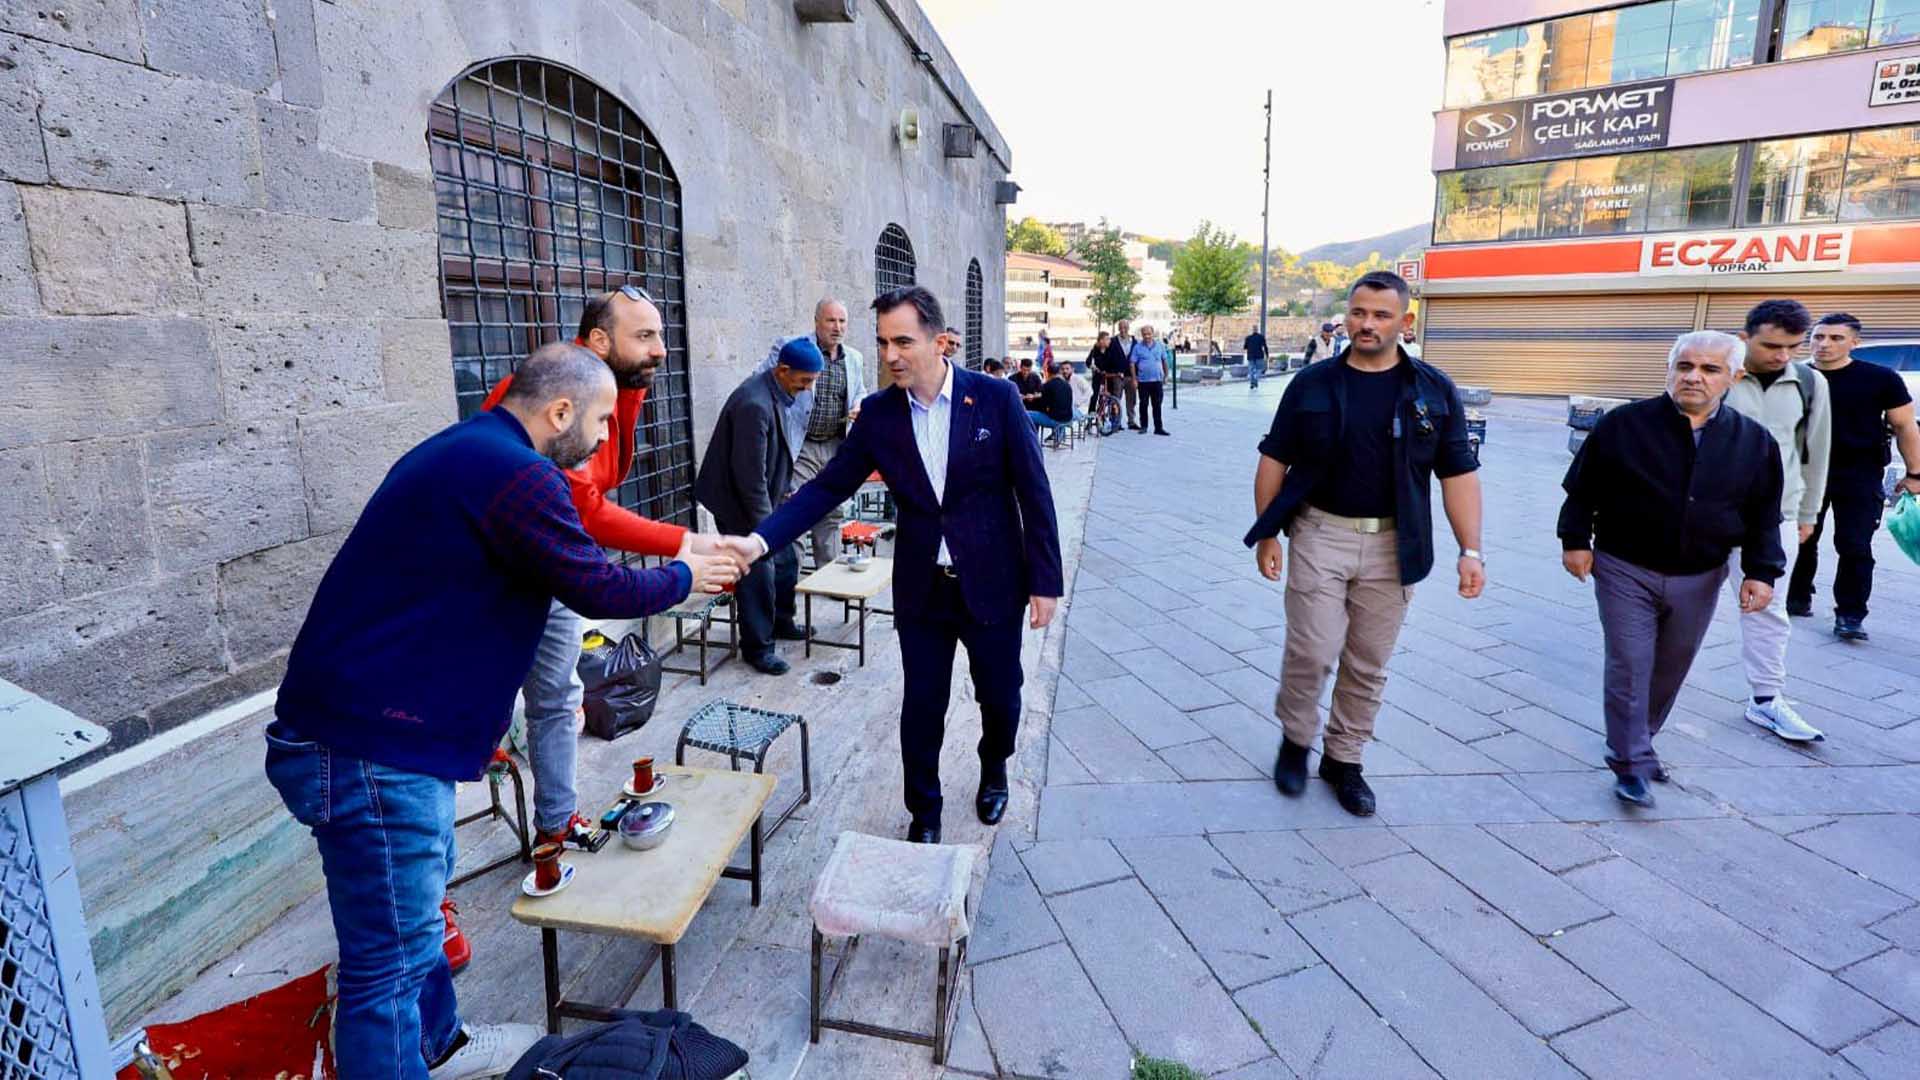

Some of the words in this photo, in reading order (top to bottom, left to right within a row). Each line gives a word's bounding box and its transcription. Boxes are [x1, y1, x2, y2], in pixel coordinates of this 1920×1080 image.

[1532, 86, 1665, 120] FORMET
[1534, 118, 1596, 144] ÇELİK
[1603, 112, 1659, 133] KAPI
[1465, 138, 1512, 152] FORMET
[1574, 136, 1634, 150] SAĞLAMLAR
[1638, 133, 1660, 143] YAPI
[1651, 233, 1843, 267] ECZANE
[1402, 264, 1414, 278] E
[1710, 262, 1768, 272] TOPRAK
